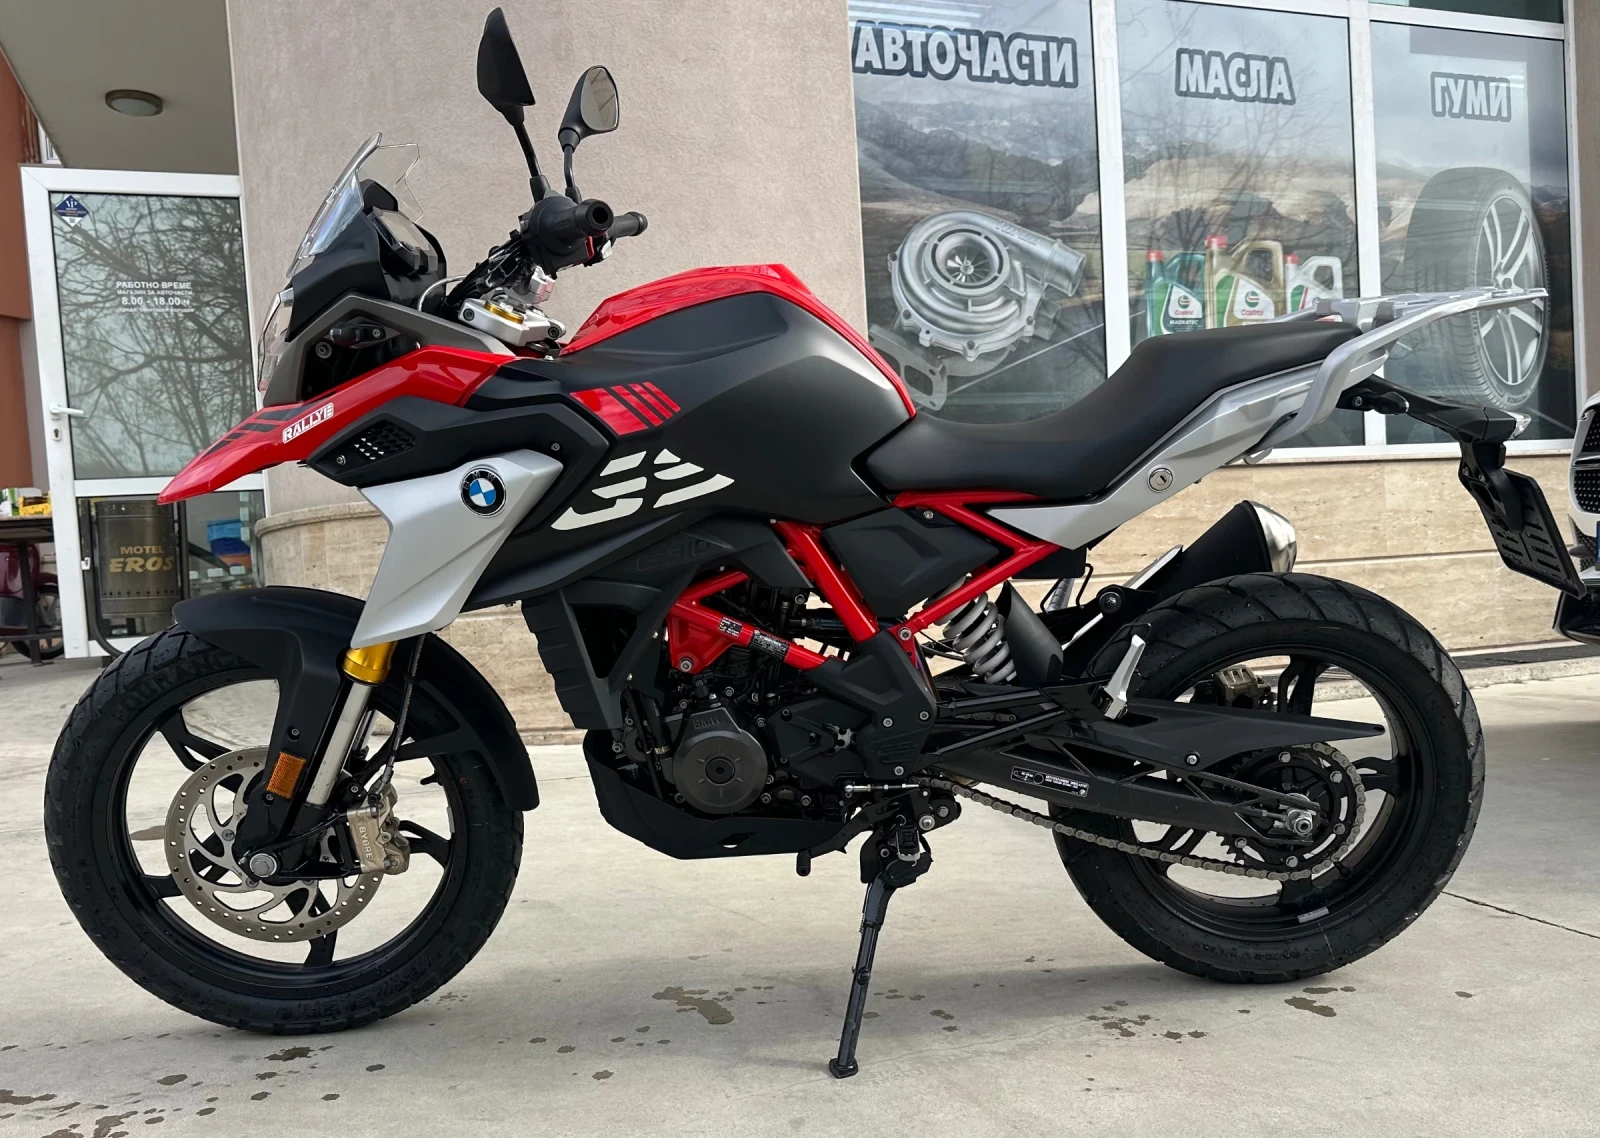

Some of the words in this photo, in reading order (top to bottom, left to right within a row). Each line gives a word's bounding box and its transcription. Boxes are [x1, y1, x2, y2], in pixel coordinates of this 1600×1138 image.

[854, 25, 1075, 84] АВТОЧАСТИ
[1178, 53, 1292, 101] МАСЛА
[1433, 76, 1509, 118] ГУМИ
[116, 281, 160, 289] РАБОТНО
[161, 281, 192, 289] ВРЕМЕ
[121, 296, 144, 306] 8.00
[153, 297, 181, 306] 18.00
[1241, 308, 1264, 317] Castrol
[283, 403, 334, 443] RALLYE
[462, 470, 497, 490] BMW
[120, 545, 165, 554] MOTEL
[109, 555, 175, 573] EROS
[692, 715, 721, 730] BMW
[358, 826, 374, 859] BYBRE
